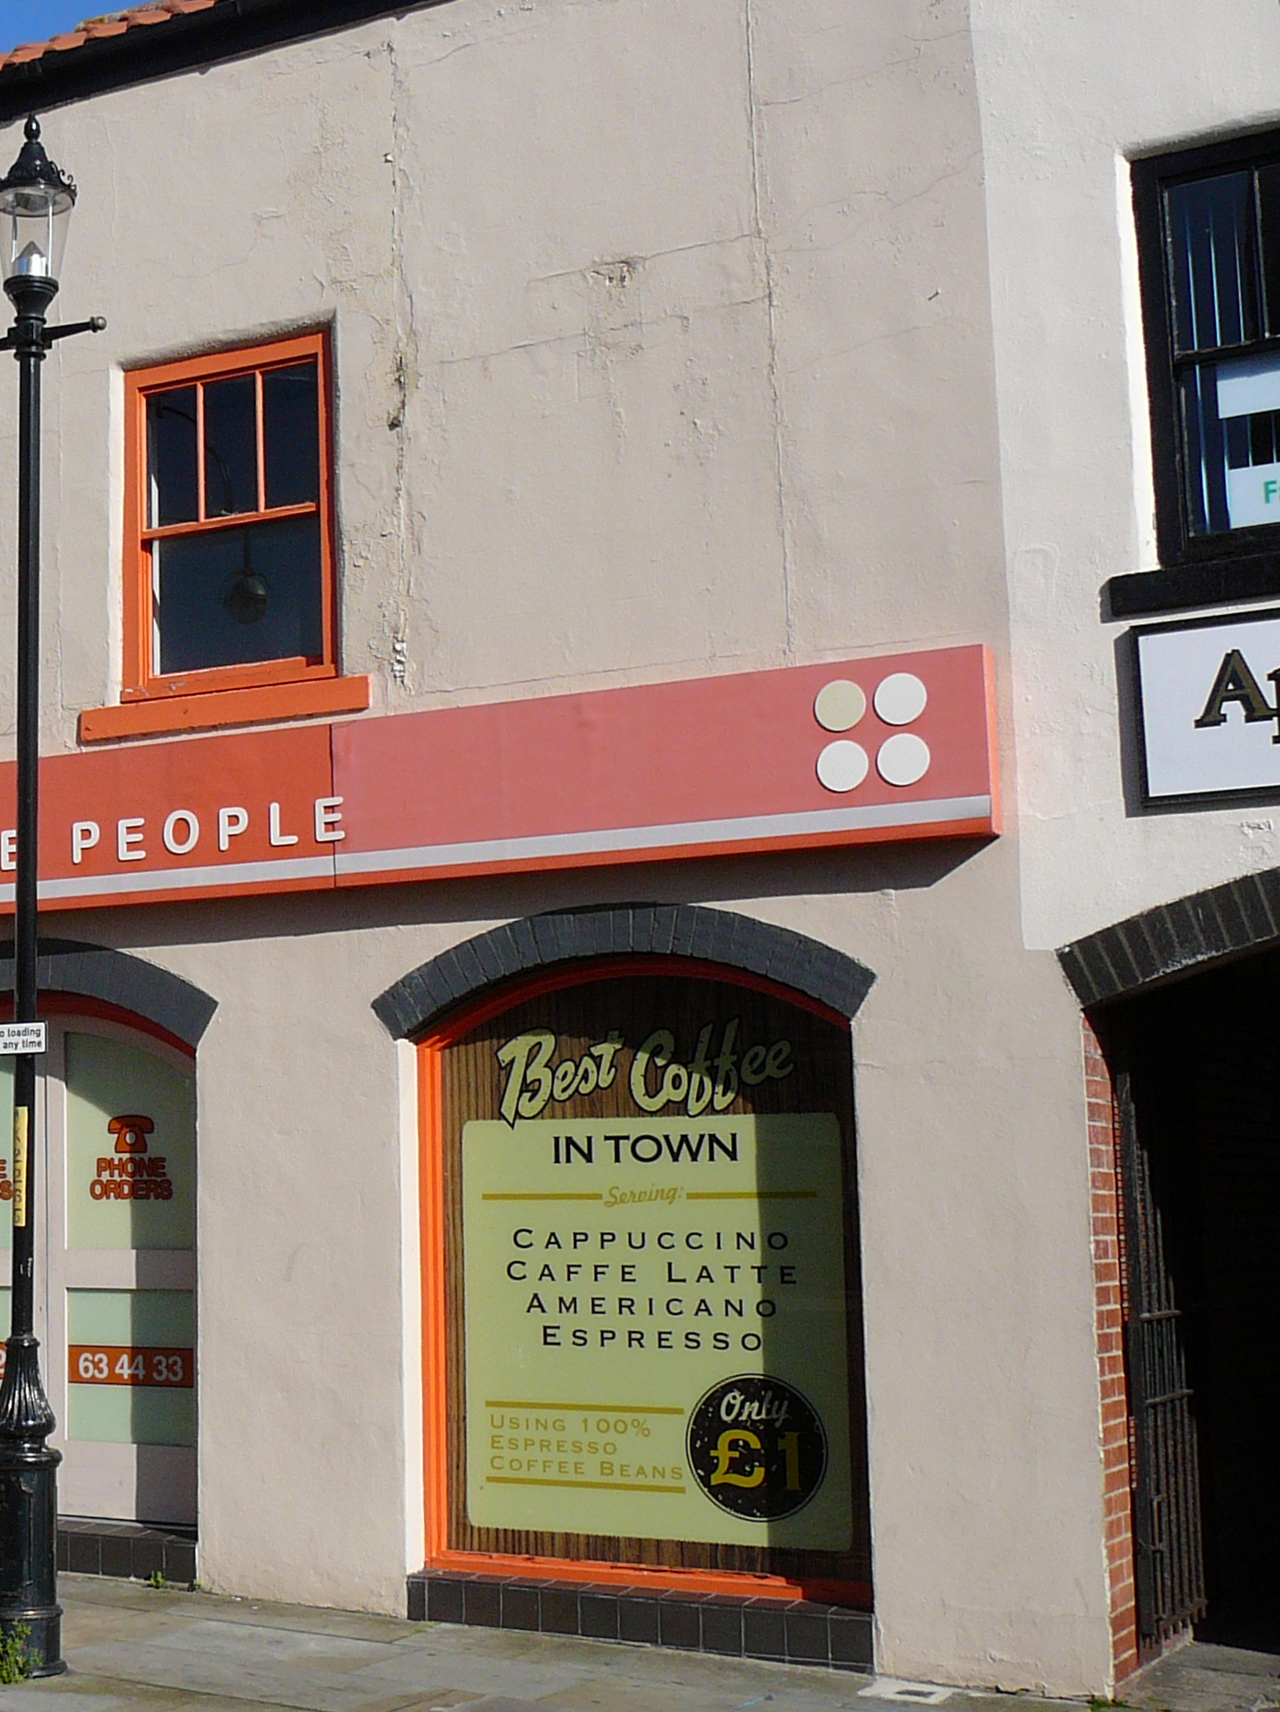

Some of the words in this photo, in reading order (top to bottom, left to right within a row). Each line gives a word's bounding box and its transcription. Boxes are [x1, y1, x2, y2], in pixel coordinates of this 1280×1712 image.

[1264, 479, 1280, 504] F
[1194, 649, 1280, 745] A
[72, 796, 345, 864] PEOPLE
[2, 1041, 19, 1051] any
[22, 1038, 42, 1048] time
[7, 1027, 41, 1038] loading
[495, 1028, 625, 1129] Best
[629, 1018, 795, 1117] Coffee
[552, 1135, 593, 1164] IN
[604, 1132, 739, 1163] TOWN
[96, 1157, 167, 1178] PHONE
[90, 1179, 173, 1200] ORDERS
[512, 1228, 789, 1250] CAPPUCCINO
[506, 1260, 637, 1283] CAFFE
[666, 1261, 797, 1285] LATTE
[526, 1293, 777, 1317] AMERICANO
[542, 1325, 762, 1351] ESPRESSO
[78, 1352, 109, 1378] 63
[114, 1354, 145, 1379] 44
[152, 1356, 183, 1381] 33
[720, 1389, 789, 1430] Only
[490, 1413, 566, 1432] USING
[581, 1417, 651, 1438] 100%
[490, 1435, 617, 1456] ESPRESSO
[490, 1455, 585, 1475] COFFEE
[599, 1461, 684, 1480] BEANS
[709, 1428, 803, 1491] £1
